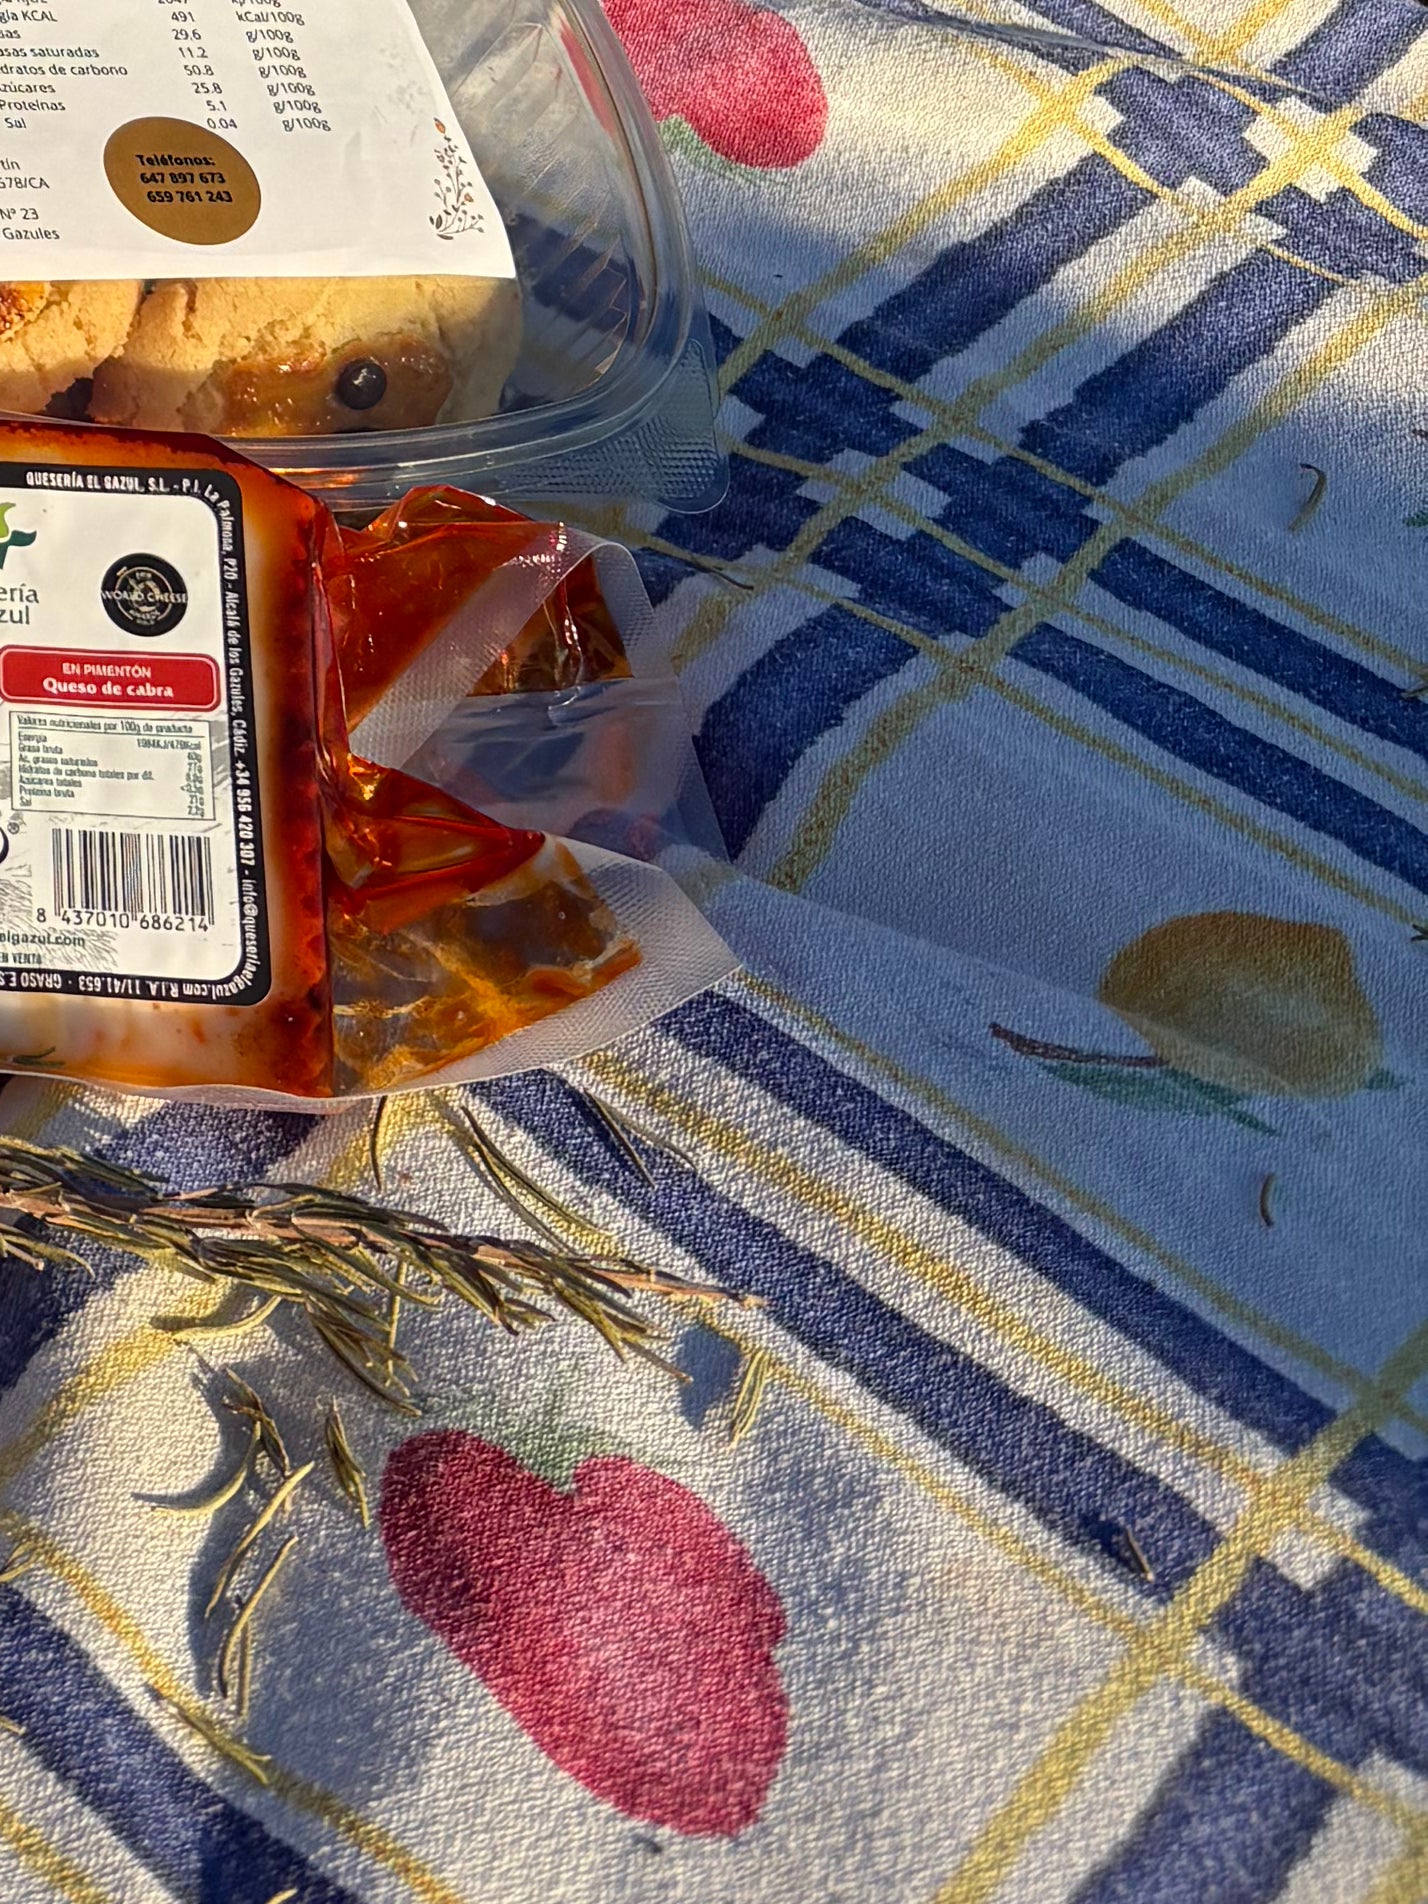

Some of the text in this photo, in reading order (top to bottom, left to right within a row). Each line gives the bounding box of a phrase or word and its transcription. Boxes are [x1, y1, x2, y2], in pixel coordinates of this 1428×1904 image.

[22, 10, 58, 22] KCAL
[171, 11, 195, 22] 491
[246, 30, 294, 43] g/100g
[30, 46, 100, 58] saturadas
[179, 47, 208, 58] 11.2
[252, 47, 300, 61] g/100g
[49, 64, 67, 75] de
[70, 64, 128, 76] carbono
[184, 65, 214, 76] 50.8
[259, 65, 307, 79] g/100g
[192, 82, 222, 94] 25.8
[267, 82, 315, 96] g/100g
[206, 100, 227, 111] 5.1
[273, 100, 321, 114] g/100g
[5, 117, 331, 132] Sal 0.04 g/100g
[135, 154, 216, 167] Teléfonos:
[140, 173, 226, 184] 647 897 673
[147, 191, 233, 203] 659 761 243
[21, 208, 39, 221] 23
[3, 228, 60, 241] Gazules
[26, 471, 84, 489] QUESERÍA
[87, 473, 101, 489] EL
[204, 484, 220, 502] La
[224, 558, 239, 580] P20
[225, 592, 240, 628] Alcalá
[227, 630, 241, 645] de
[229, 647, 242, 664] los
[62, 662, 152, 679] EN PIMENTÓN
[43, 678, 174, 698] Queso de cabra
[229, 667, 245, 716] Gazules,
[235, 762, 251, 786] +34
[237, 787, 253, 812] 956
[239, 814, 254, 839] 420
[240, 841, 256, 866] 307
[36, 907, 209, 932] 8 437010 686214
[22, 973, 62, 990] GRASO
[78, 976, 140, 996] 11/41.653
